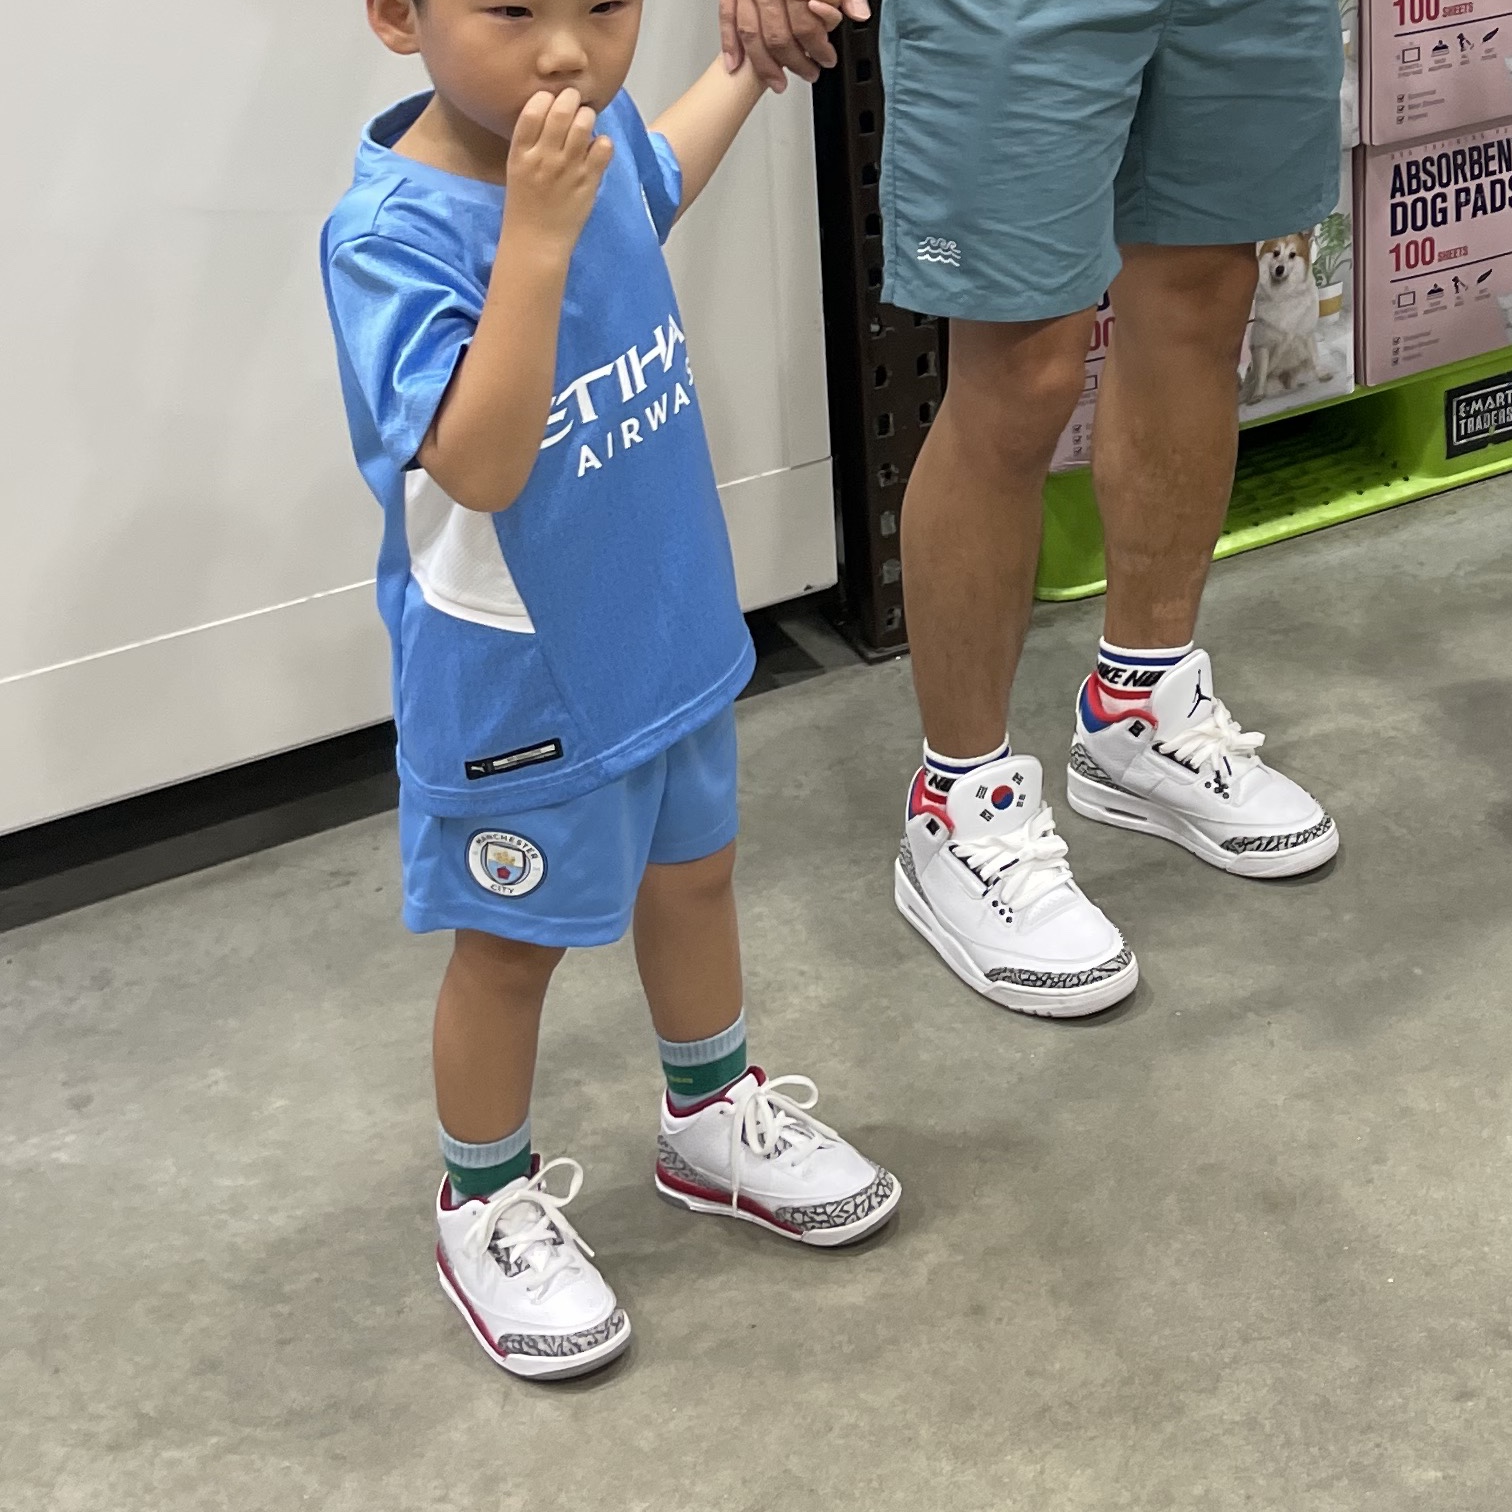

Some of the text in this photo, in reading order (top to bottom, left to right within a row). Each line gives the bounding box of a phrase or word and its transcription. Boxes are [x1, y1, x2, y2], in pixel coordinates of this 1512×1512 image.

[1442, 1, 1474, 18] SHEETS
[1390, 194, 1448, 238] DOG
[1389, 236, 1435, 273] 100
[540, 314, 686, 449] ETIHA
[474, 832, 543, 862] MANCHESTER
[490, 883, 515, 895] CITY
